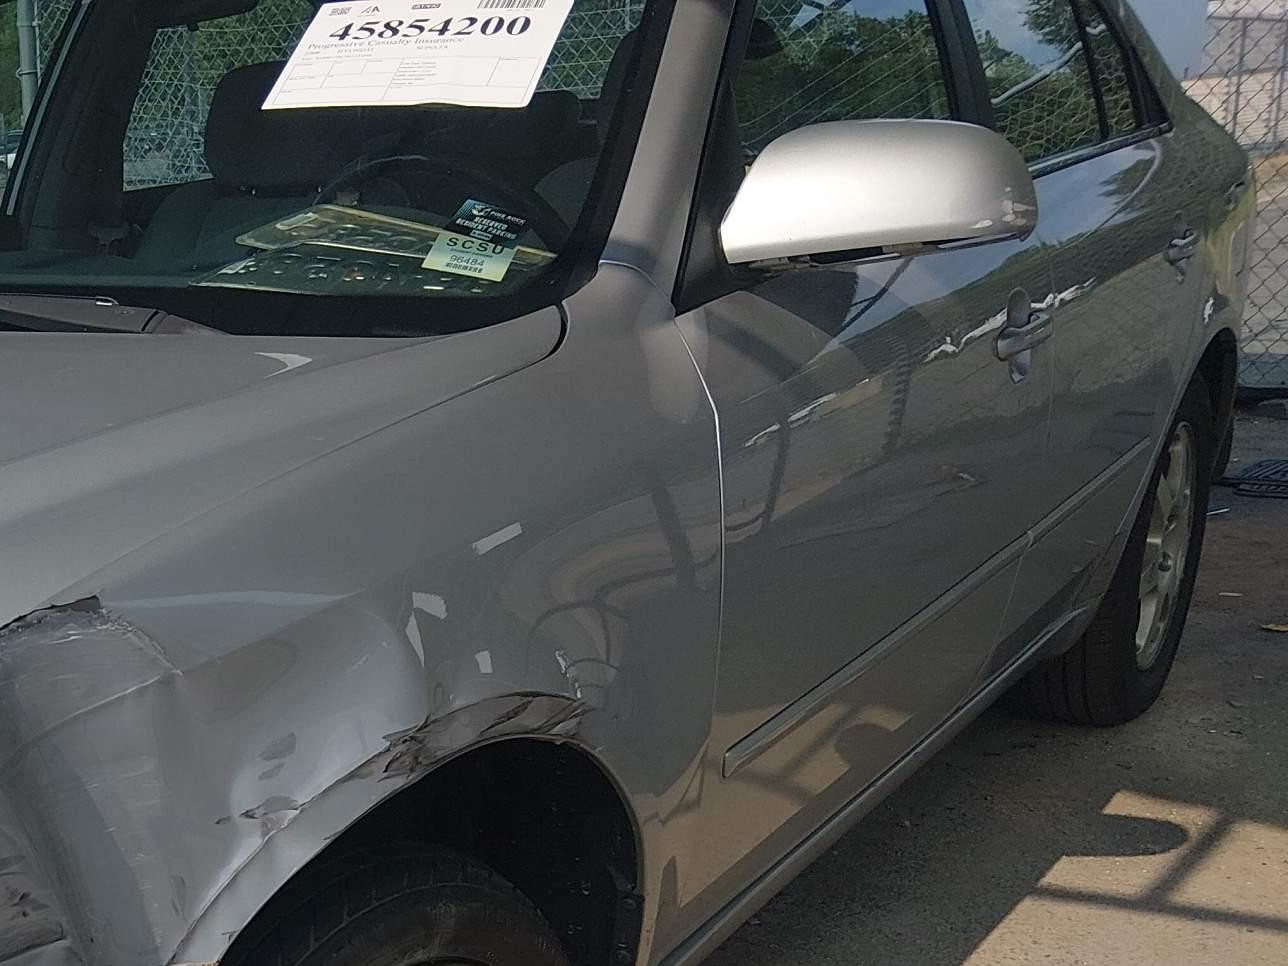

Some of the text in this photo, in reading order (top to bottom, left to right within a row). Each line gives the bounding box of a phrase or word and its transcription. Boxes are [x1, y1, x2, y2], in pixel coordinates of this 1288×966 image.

[329, 15, 531, 40] 45854200
[307, 36, 465, 50] Progressive Casualty Insurance
[473, 217, 508, 230] RESERVED
[488, 228, 517, 239] PARKING
[446, 237, 504, 254] SCSU
[450, 255, 484, 266] 96484
